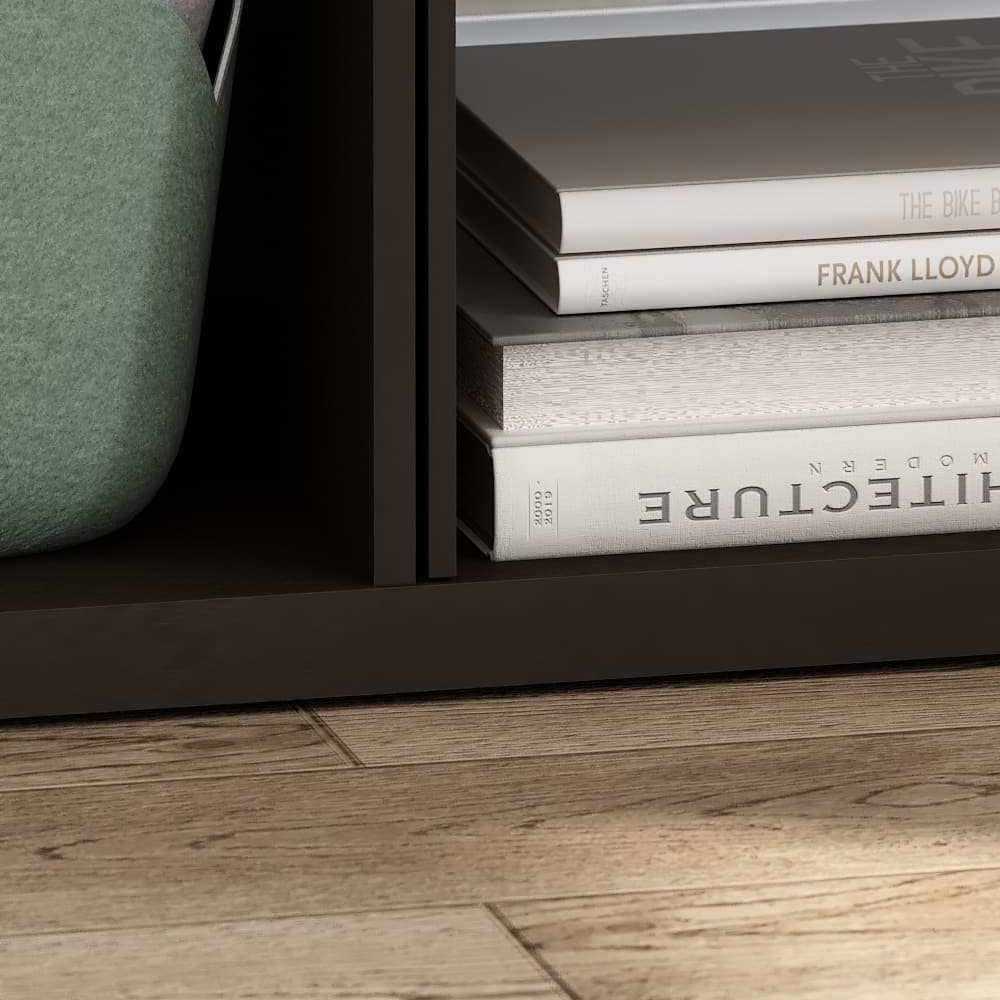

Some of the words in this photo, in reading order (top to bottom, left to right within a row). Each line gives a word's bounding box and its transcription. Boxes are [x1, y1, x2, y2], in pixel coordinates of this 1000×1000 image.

[899, 192, 932, 221] THE
[943, 189, 981, 217] BIKE
[817, 258, 903, 287] FRANK
[911, 253, 995, 280] LLOYD
[809, 452, 989, 476] MODERN
[534, 491, 542, 526] 2000
[544, 490, 552, 526] 2019
